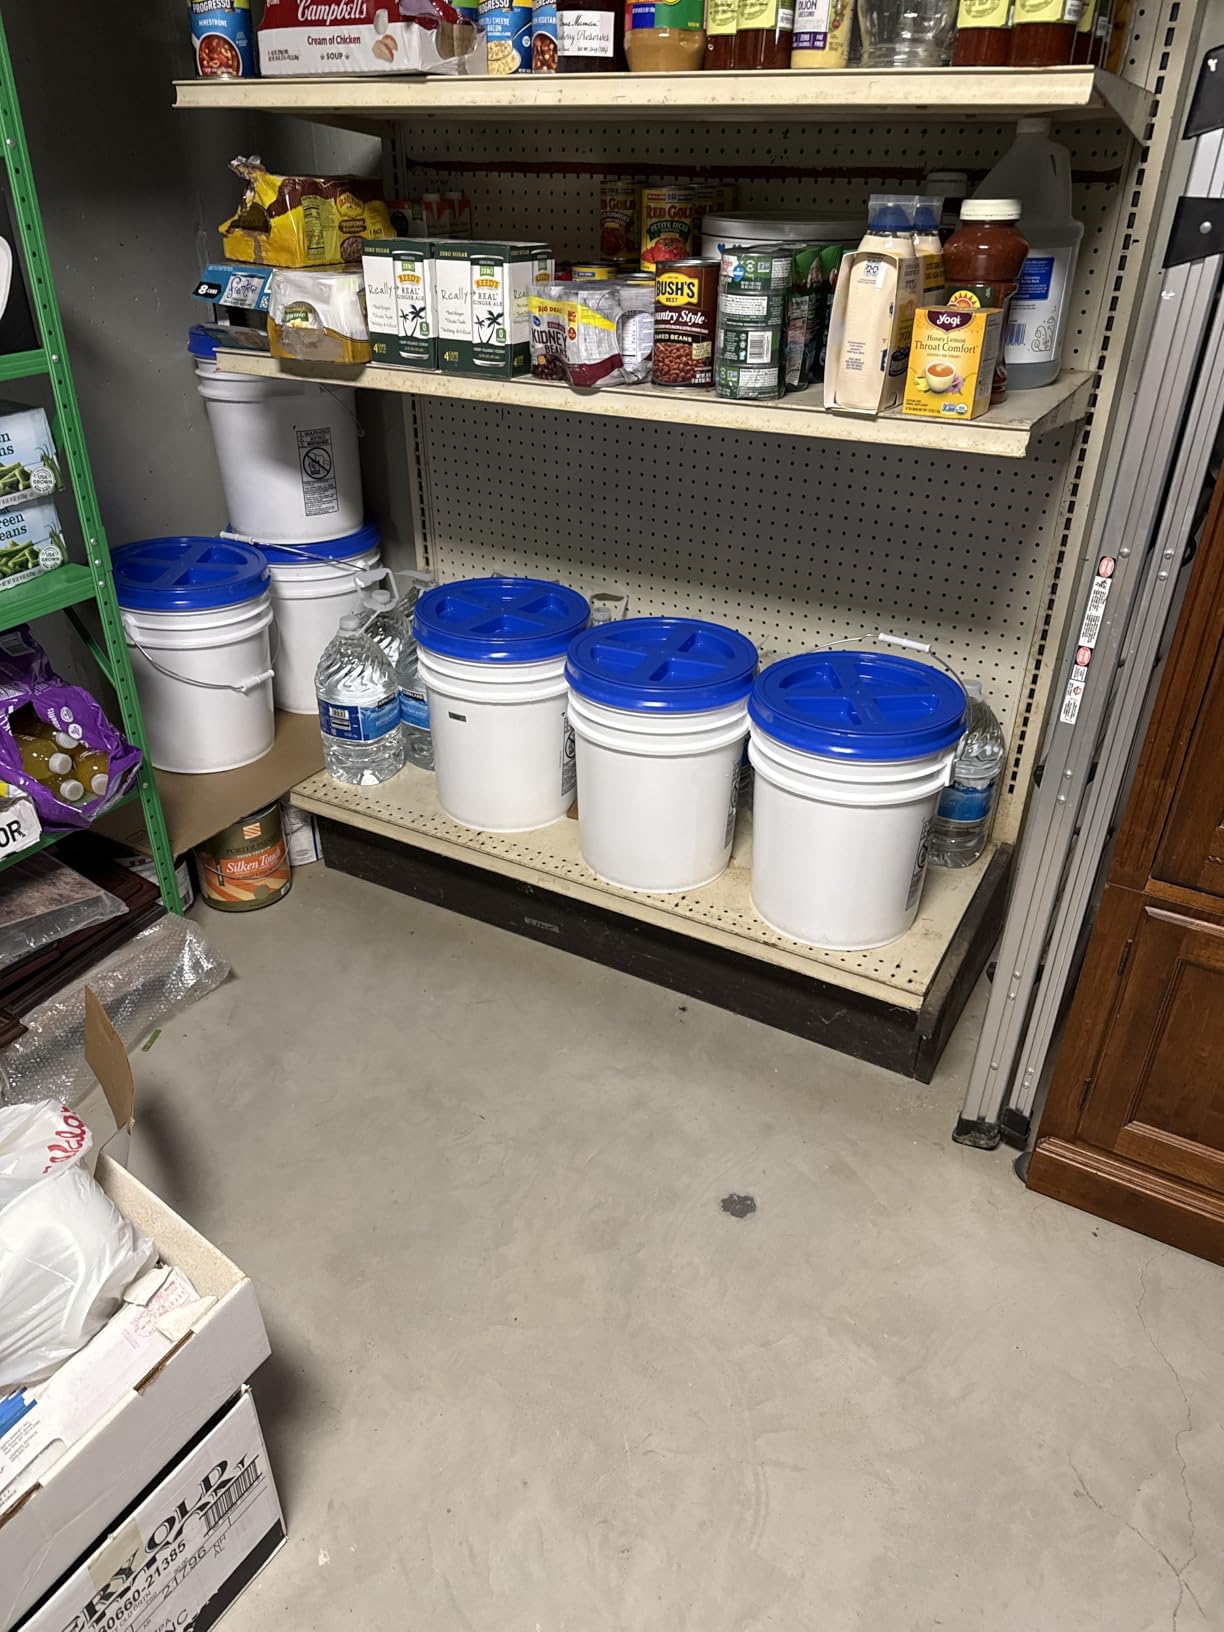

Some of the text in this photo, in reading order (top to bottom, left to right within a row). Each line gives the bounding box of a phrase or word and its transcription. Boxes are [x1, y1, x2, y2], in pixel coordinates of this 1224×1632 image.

[307, 34, 361, 45] Cream of Chicken
[326, 52, 344, 60] SOUP
[650, 221, 690, 233] PETITE DICED
[198, 284, 209, 294] 8
[367, 281, 393, 299] Really
[440, 287, 469, 304] Really
[656, 281, 695, 299] BUSH'S
[478, 292, 497, 301] REAL
[680, 310, 705, 325] Style
[531, 327, 568, 350] KIDNEY
[927, 334, 966, 344] Honey Lemon
[373, 343, 378, 353] 4
[914, 340, 976, 354] Throat Comfort
[443, 351, 449, 361] 4
[226, 847, 281, 873] Silken Touch
[145, 1460, 228, 1553] OLD
[161, 1546, 207, 1600] 21796
